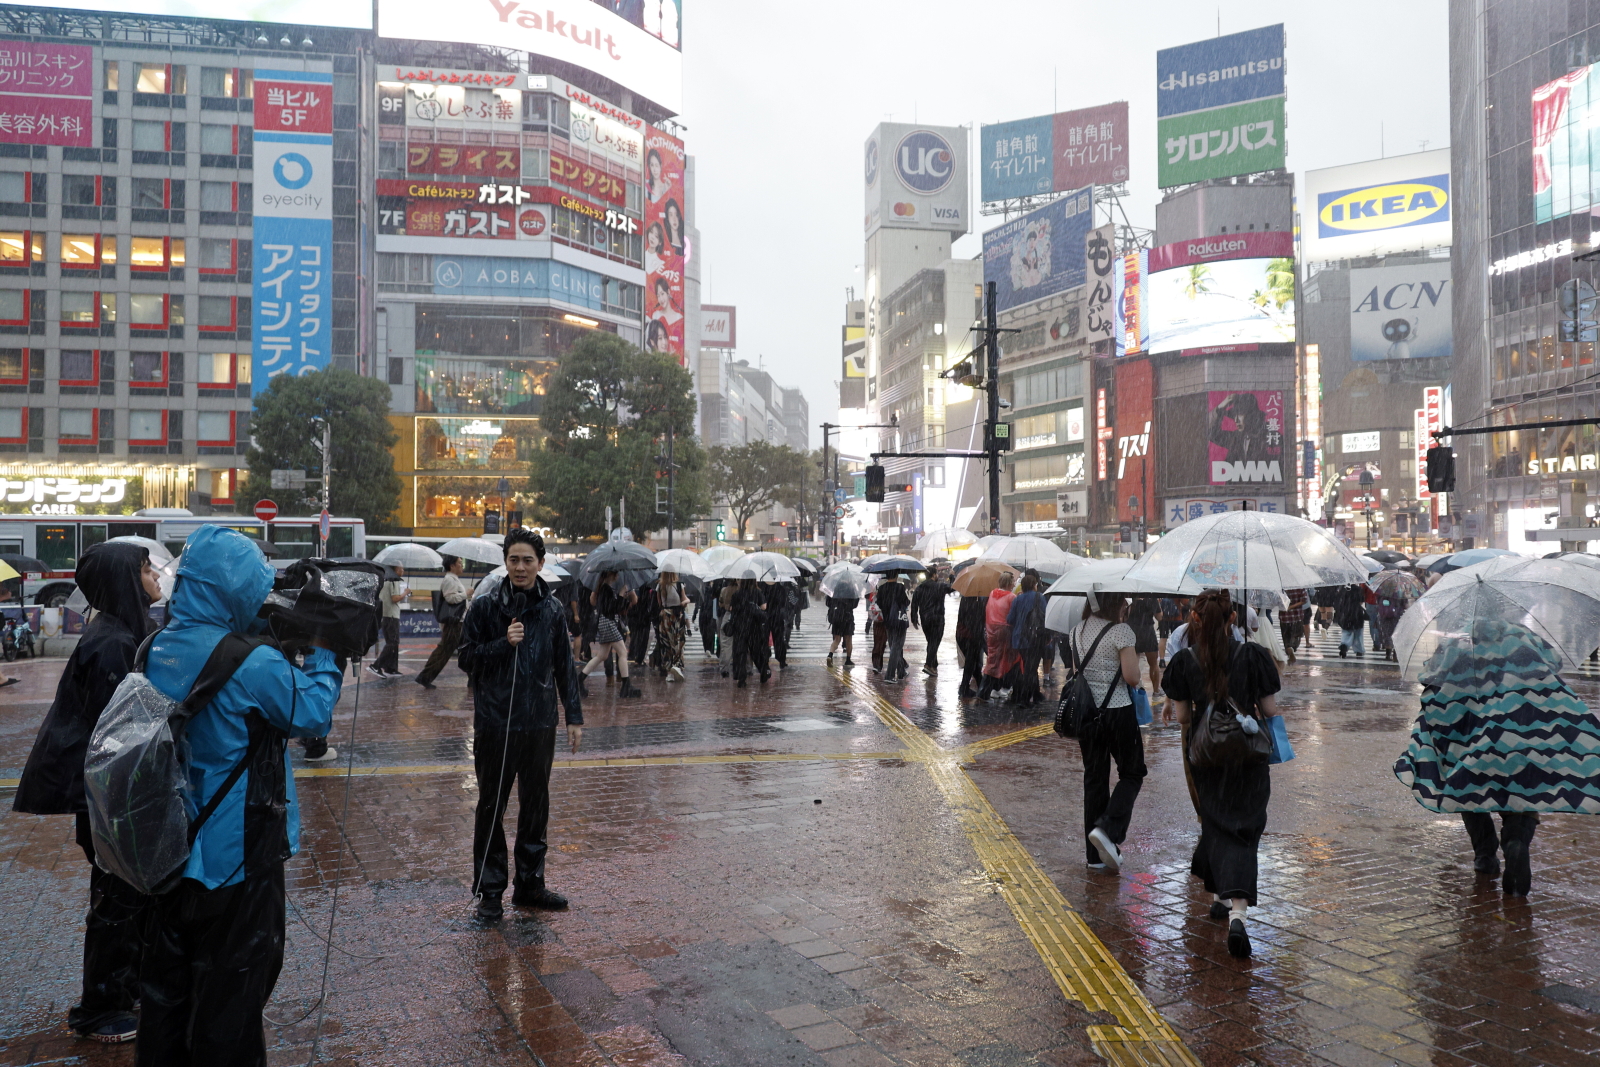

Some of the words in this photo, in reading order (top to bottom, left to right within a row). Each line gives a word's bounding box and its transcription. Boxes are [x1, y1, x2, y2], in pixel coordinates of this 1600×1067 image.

[488, 0, 621, 60] Yakult
[0, 51, 83, 69] 品川スキン
[0, 69, 74, 88] クリニック
[396, 68, 517, 87] しゃぶしゃぶバイキング
[1159, 57, 1282, 91] Hisamitsu
[267, 88, 320, 107] 当ビル
[381, 97, 403, 112] 9F
[446, 97, 514, 121] しゃぶ葉
[0, 112, 83, 137] 美容外科
[280, 109, 307, 126] 5F
[595, 124, 638, 159] しゃぶ葉
[1068, 121, 1114, 146] 龍角散
[1165, 120, 1277, 165] サロンパス
[409, 146, 516, 170] プライス
[995, 134, 1038, 159] 龍角散
[550, 155, 623, 199] コンタクト
[262, 193, 322, 210] eyecity
[478, 183, 531, 205] ガスト
[1331, 190, 1438, 222] IKEA
[379, 210, 406, 226] 7F
[444, 208, 511, 237] ガスト
[605, 209, 638, 235] ガスト
[933, 207, 960, 219] VISA
[1187, 239, 1247, 257] Rakuten
[477, 268, 536, 284] AOBA
[551, 273, 601, 298] CLINIC
[1088, 230, 1113, 337] もんじゃ
[1352, 280, 1449, 313] ACN
[1211, 460, 1283, 482] DMM
[1527, 454, 1597, 475] STAR
[31, 503, 77, 515] CARER
[1170, 501, 1278, 522] 大盛堂店
